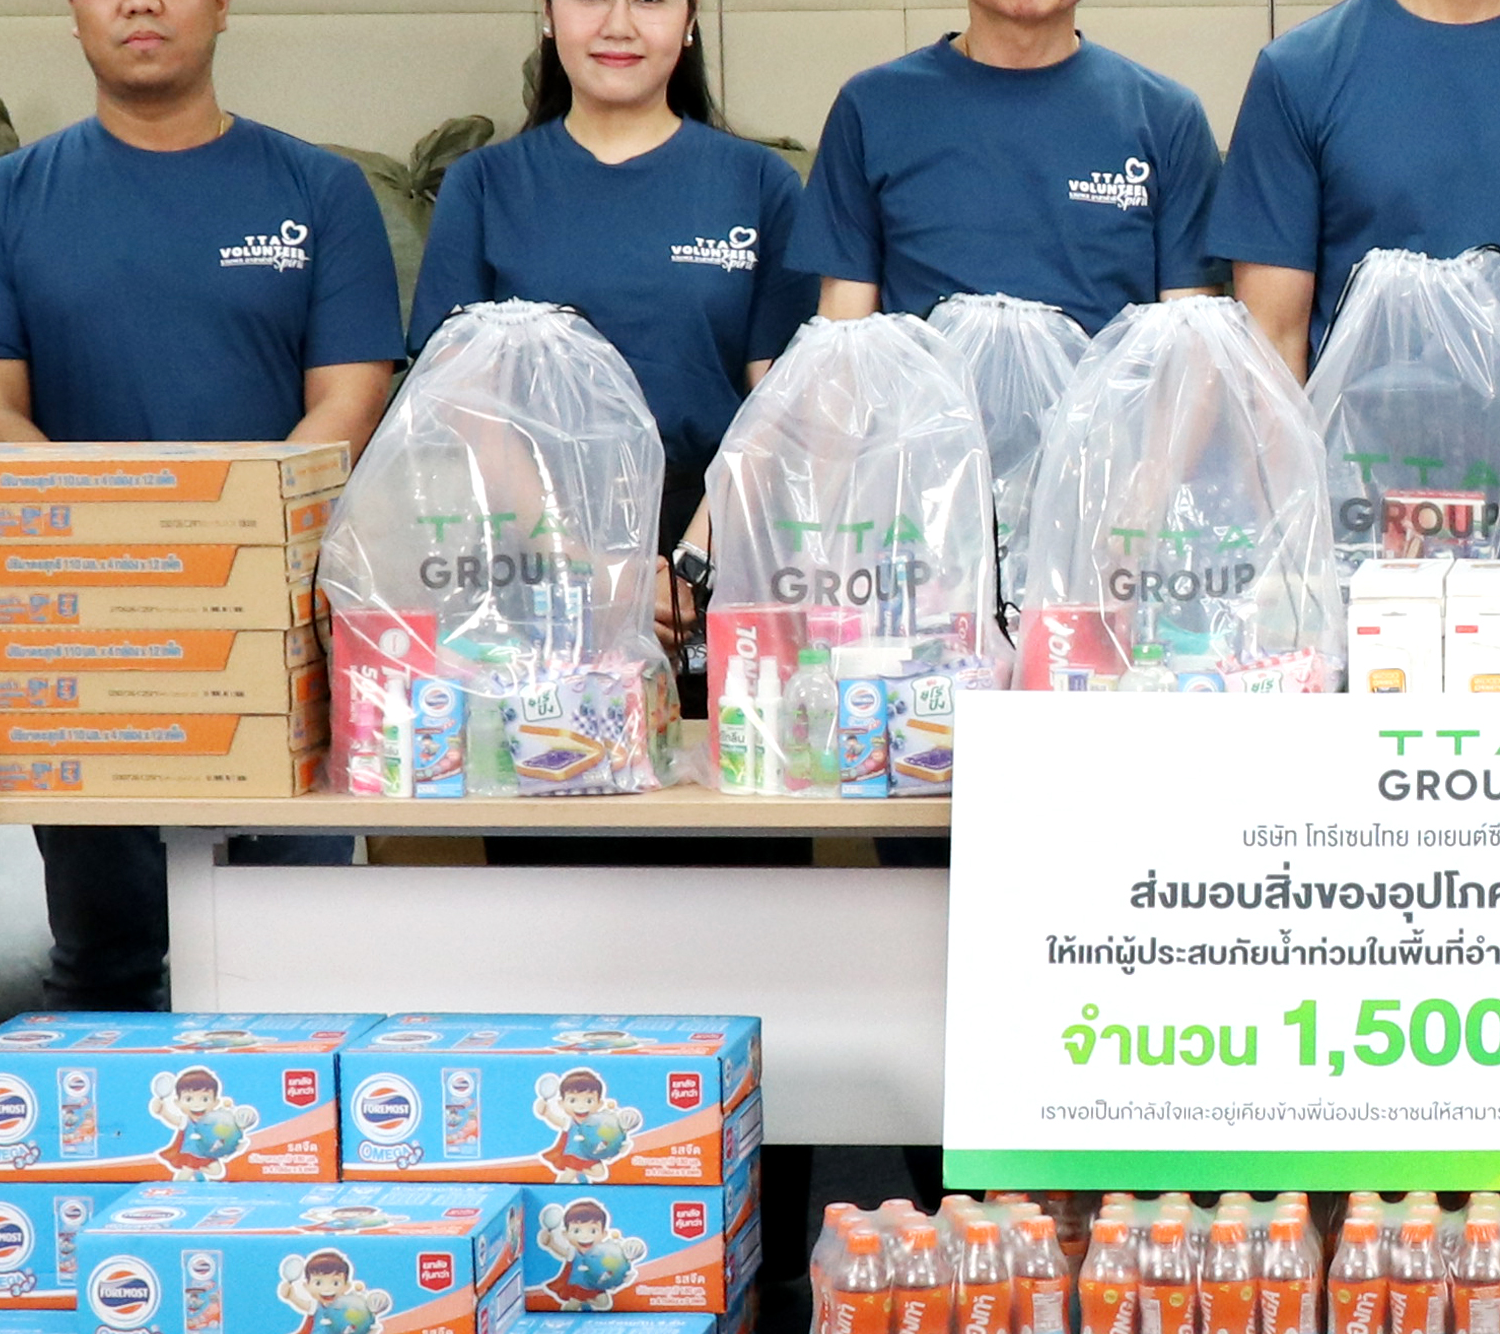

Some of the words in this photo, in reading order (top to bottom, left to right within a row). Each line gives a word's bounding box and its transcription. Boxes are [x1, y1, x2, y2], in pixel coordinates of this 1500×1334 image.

[1091, 171, 1125, 183] TTA
[244, 236, 281, 247] TTA
[695, 237, 728, 248] TTA
[1339, 497, 1499, 539] GROUP
[771, 561, 932, 606] GROUP
[1108, 563, 1256, 602] GROUP
[1243, 824, 1297, 848] บริษัท
[1305, 823, 1409, 848] โทรีเซนไทย
[1060, 1003, 1257, 1066] จำนวน
[99, 1286, 149, 1300] FOREMOST
